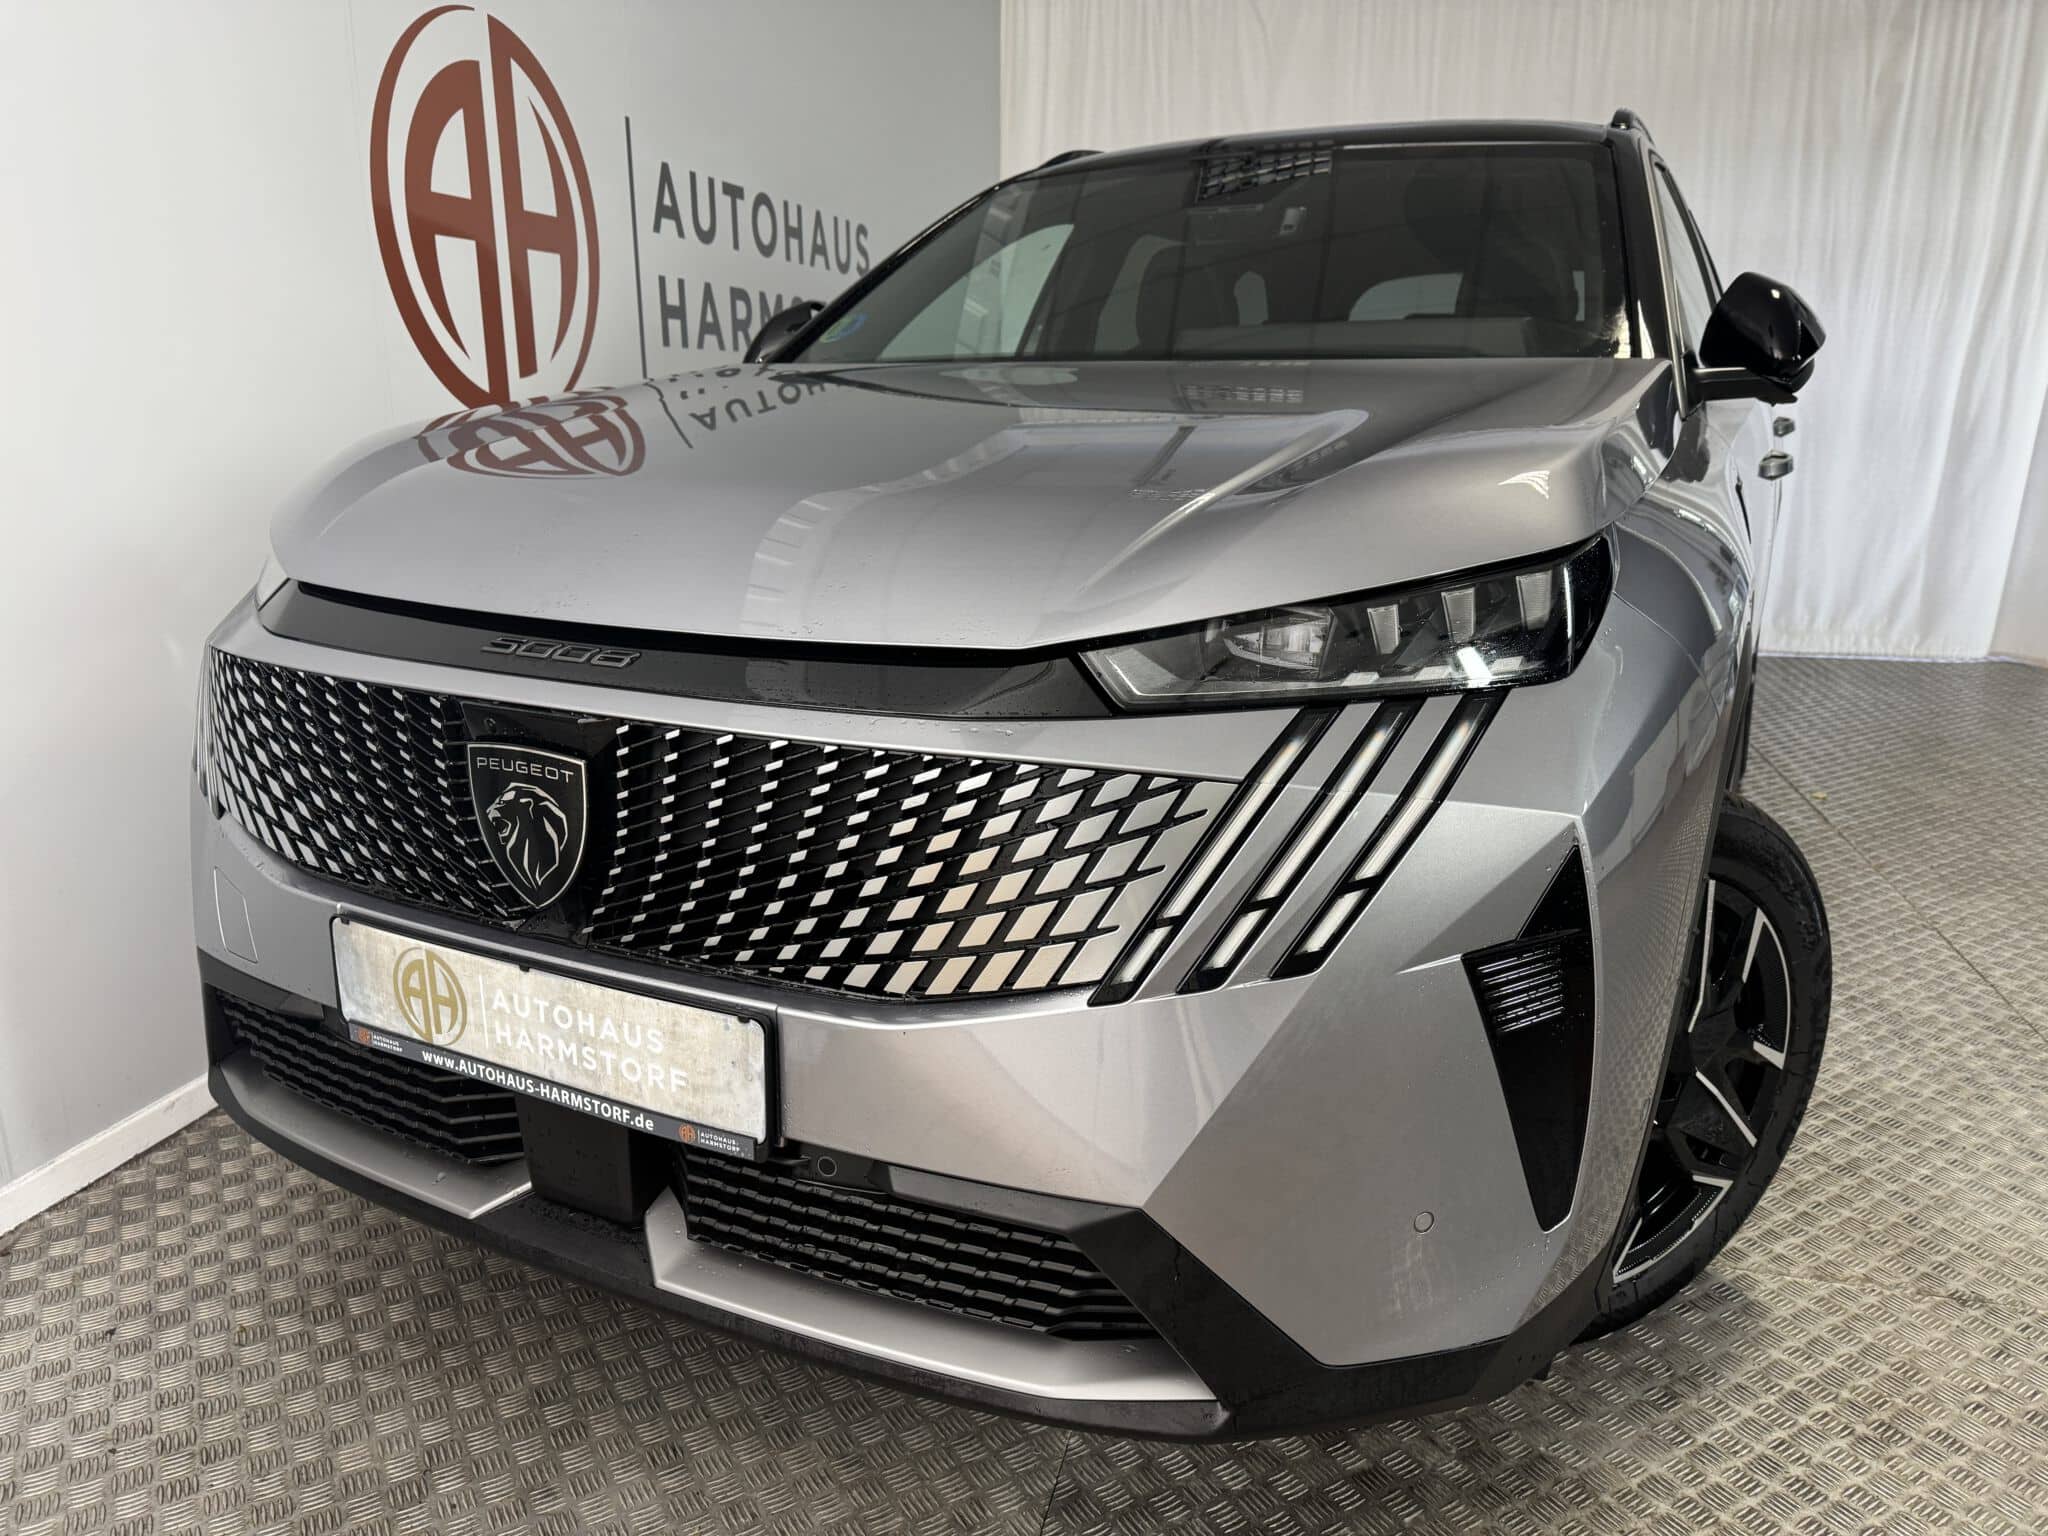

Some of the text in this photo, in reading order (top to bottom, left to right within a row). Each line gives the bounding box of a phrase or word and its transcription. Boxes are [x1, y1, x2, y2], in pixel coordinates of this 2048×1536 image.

[652, 161, 870, 276] AUTOHAUS
[658, 274, 806, 352] HARM
[480, 635, 641, 668] 5008
[476, 756, 574, 783] PEUGEOT
[492, 988, 665, 1055] AUTOHAUS
[495, 1020, 689, 1093] HARMSTORF
[422, 1050, 654, 1131] www.AUTOHAUS-HARMSTORF.de
[700, 1132, 736, 1145] AUTOHAUS
